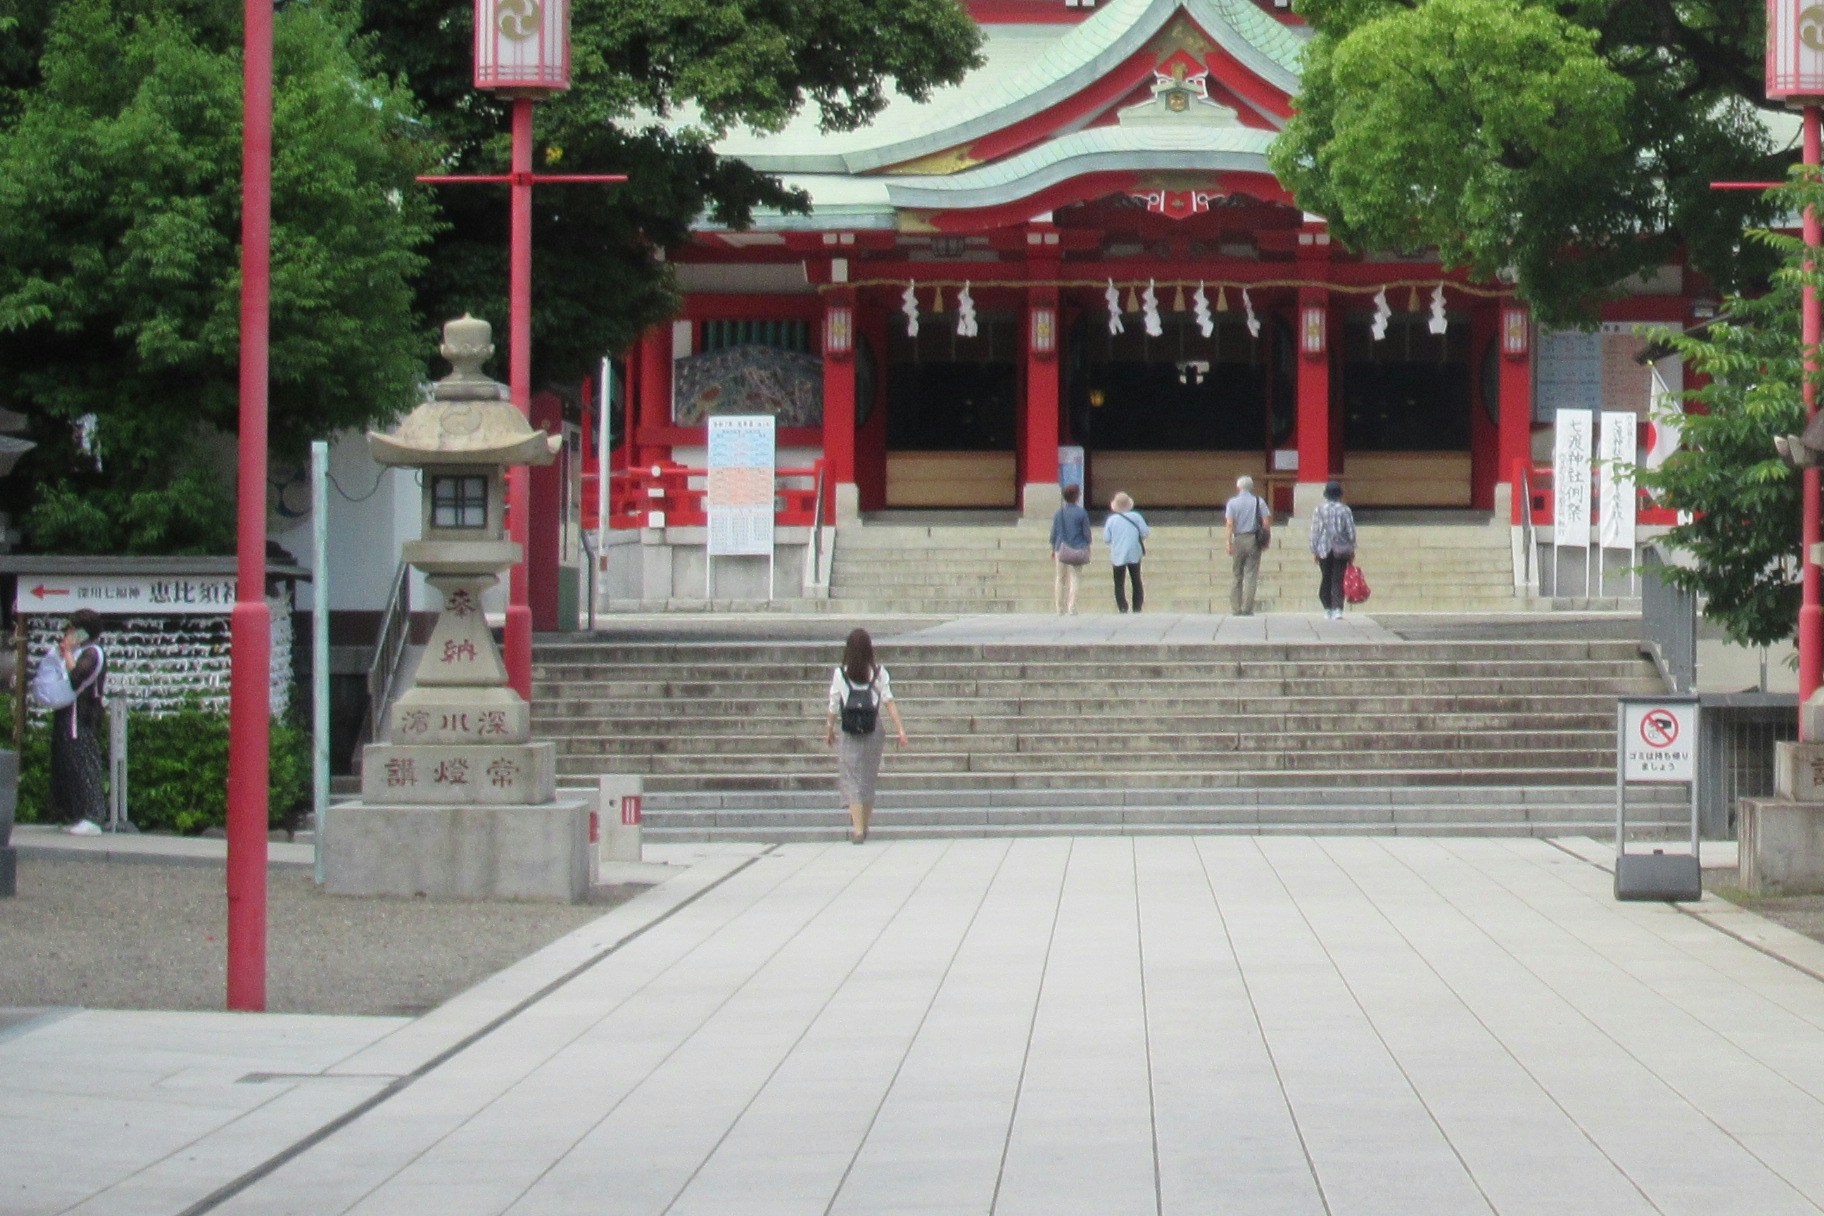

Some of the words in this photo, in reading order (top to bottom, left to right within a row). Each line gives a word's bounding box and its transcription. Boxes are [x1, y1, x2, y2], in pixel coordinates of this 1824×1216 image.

[77, 587, 140, 599] 深川七福神
[441, 589, 477, 663] 奉納
[1629, 752, 1688, 760] ゴミは持ち帰り
[1641, 763, 1675, 771] ましょう
